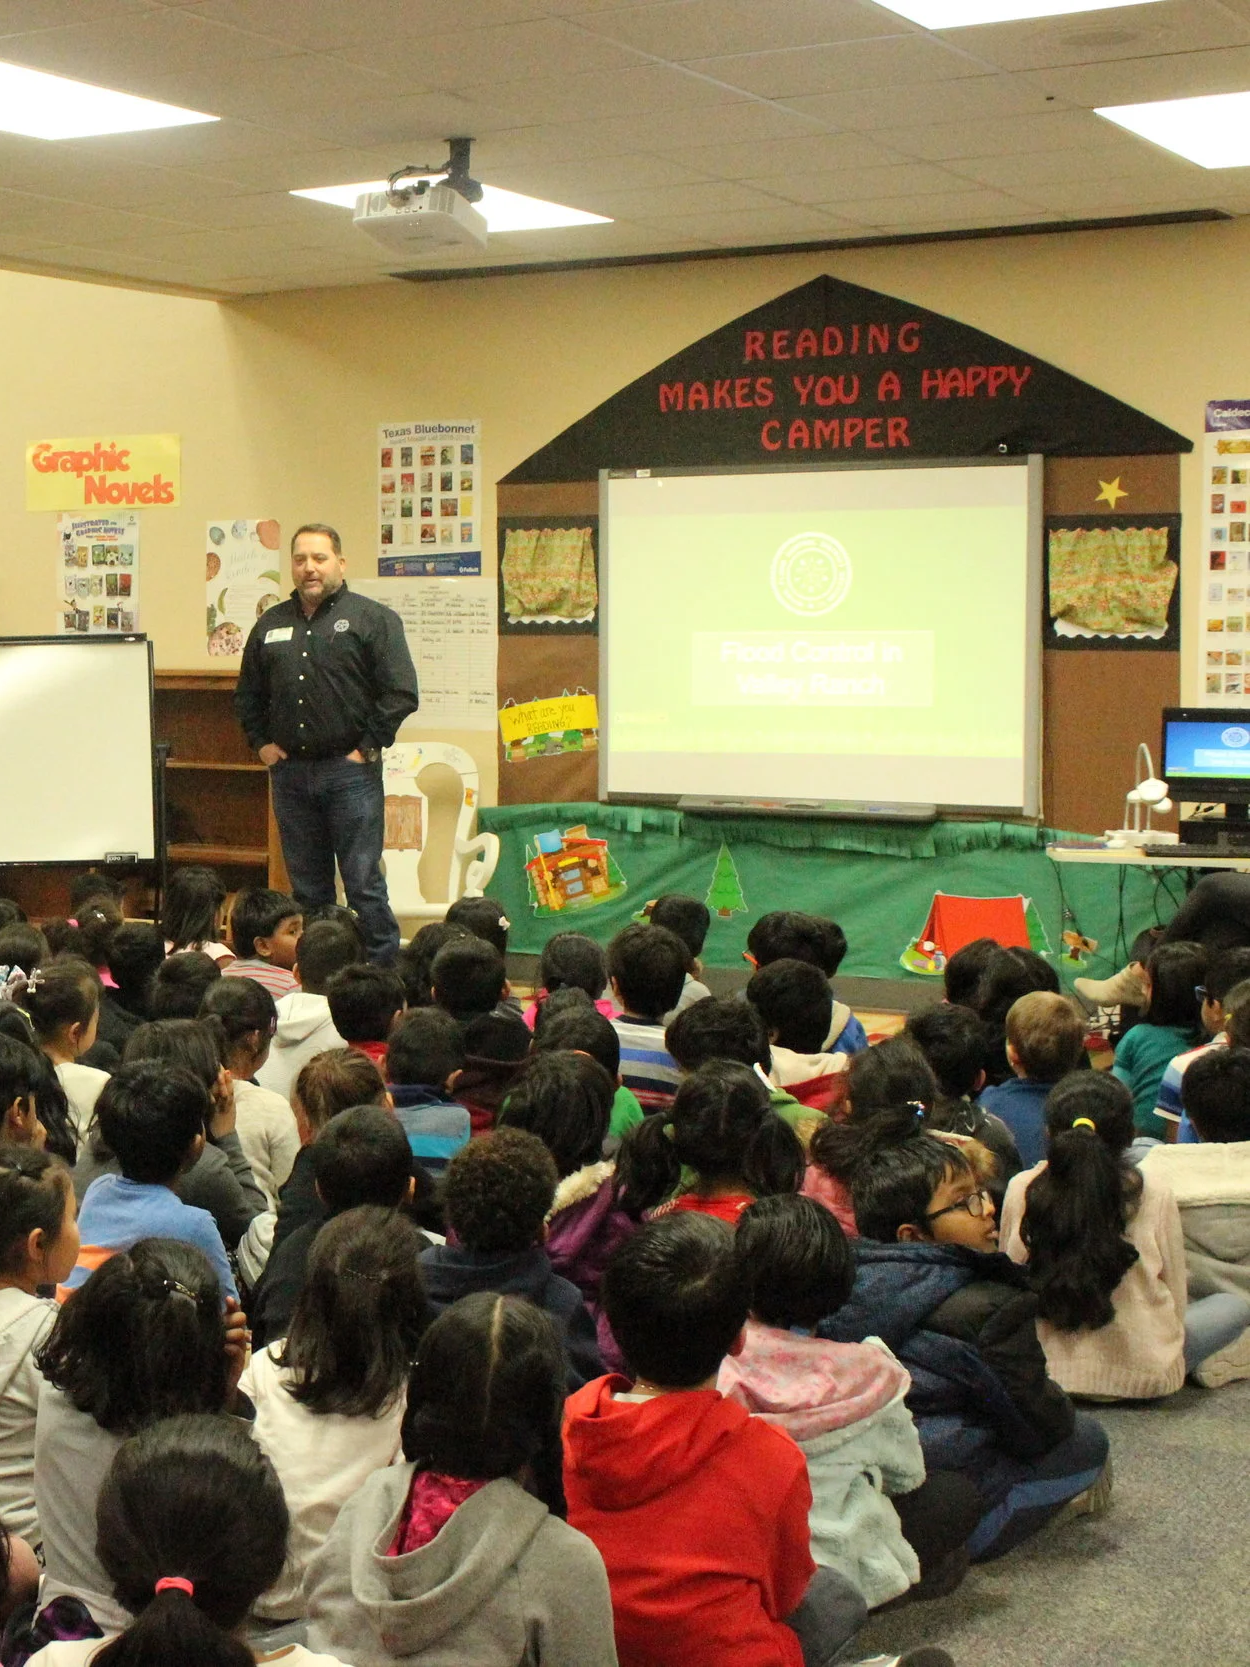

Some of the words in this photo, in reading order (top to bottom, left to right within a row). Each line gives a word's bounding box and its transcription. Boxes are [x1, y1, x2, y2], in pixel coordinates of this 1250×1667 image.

[743, 322, 921, 362] READING
[659, 377, 774, 412] MAKES
[793, 374, 859, 407] YOU
[877, 371, 901, 401] A
[921, 365, 1031, 399] HAPPY
[383, 427, 411, 438] Texas
[414, 424, 475, 434] Bluebonnet
[761, 417, 910, 451] CAMPER
[32, 442, 131, 478] Graphic
[84, 474, 174, 505] Novels
[720, 640, 785, 663] Flood
[791, 640, 875, 663] Control
[882, 641, 903, 663] in
[809, 673, 885, 695] Ranch
[510, 708, 538, 726] What
[541, 706, 557, 718] are
[558, 704, 575, 719] you
[527, 716, 572, 734] READING?
